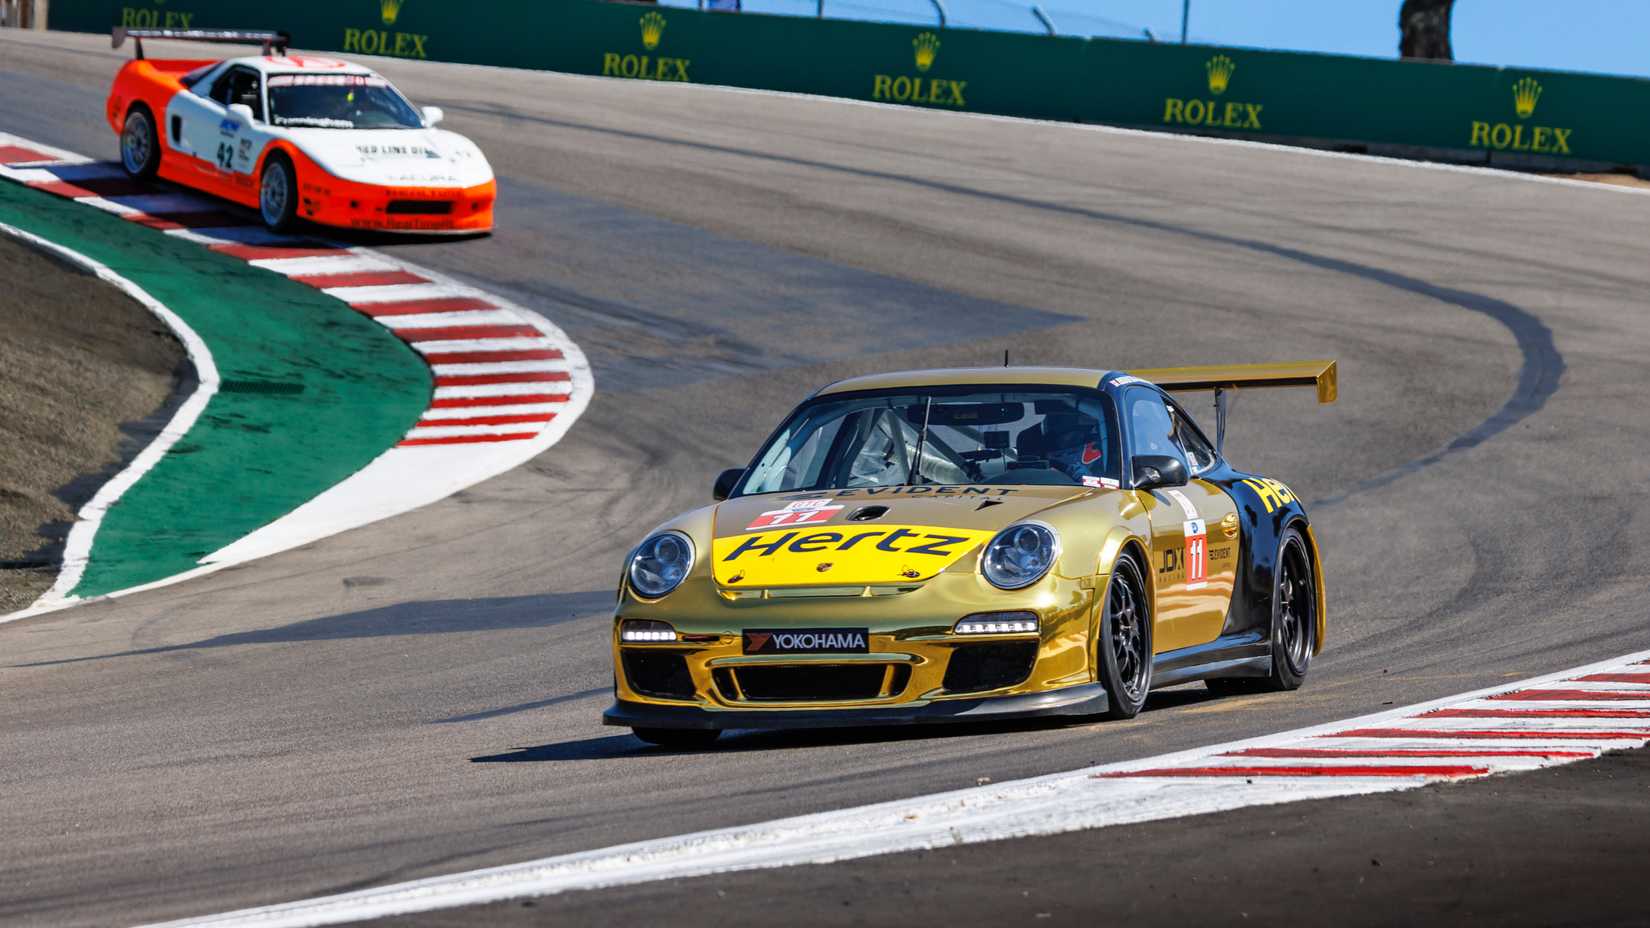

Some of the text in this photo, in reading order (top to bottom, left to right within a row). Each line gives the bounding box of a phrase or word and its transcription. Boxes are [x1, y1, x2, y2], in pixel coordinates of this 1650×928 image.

[122, 7, 193, 31] ROLEX
[343, 28, 429, 58] ROLEX
[602, 52, 690, 81] ROLEX
[872, 74, 967, 105] ROLEX
[1163, 98, 1263, 129] ROLEX
[1470, 120, 1572, 153] ROLEX
[217, 142, 233, 169] 42
[836, 486, 1018, 497] EVIDENT
[722, 528, 970, 562] Hertz
[1190, 539, 1203, 580] 11
[772, 633, 866, 649] YOKOHAMA
